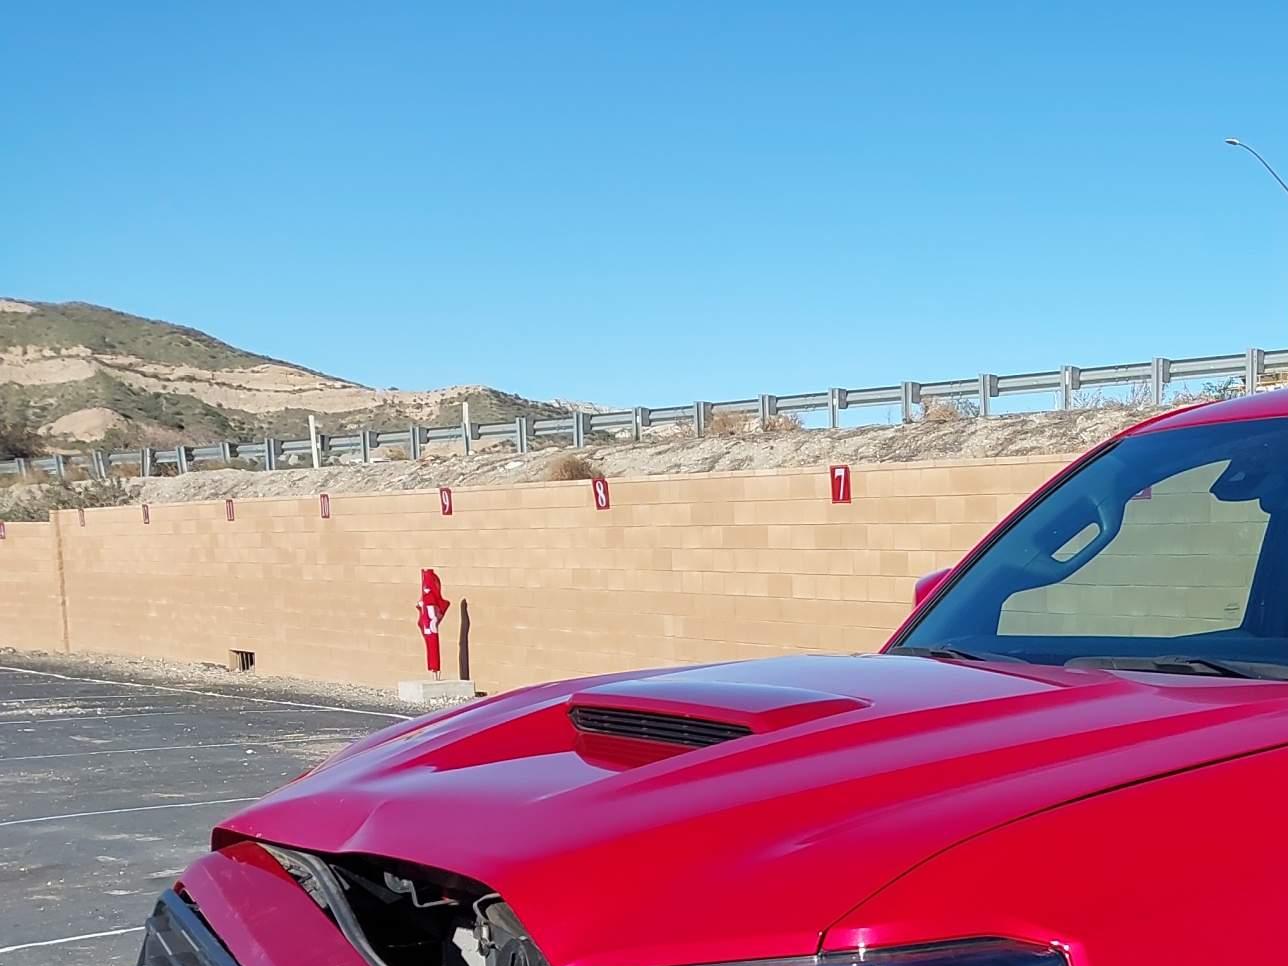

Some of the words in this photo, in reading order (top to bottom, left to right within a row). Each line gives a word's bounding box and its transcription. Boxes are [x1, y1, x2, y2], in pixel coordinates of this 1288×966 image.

[595, 480, 606, 507] 8
[834, 468, 845, 500] 7
[441, 490, 450, 513] 9
